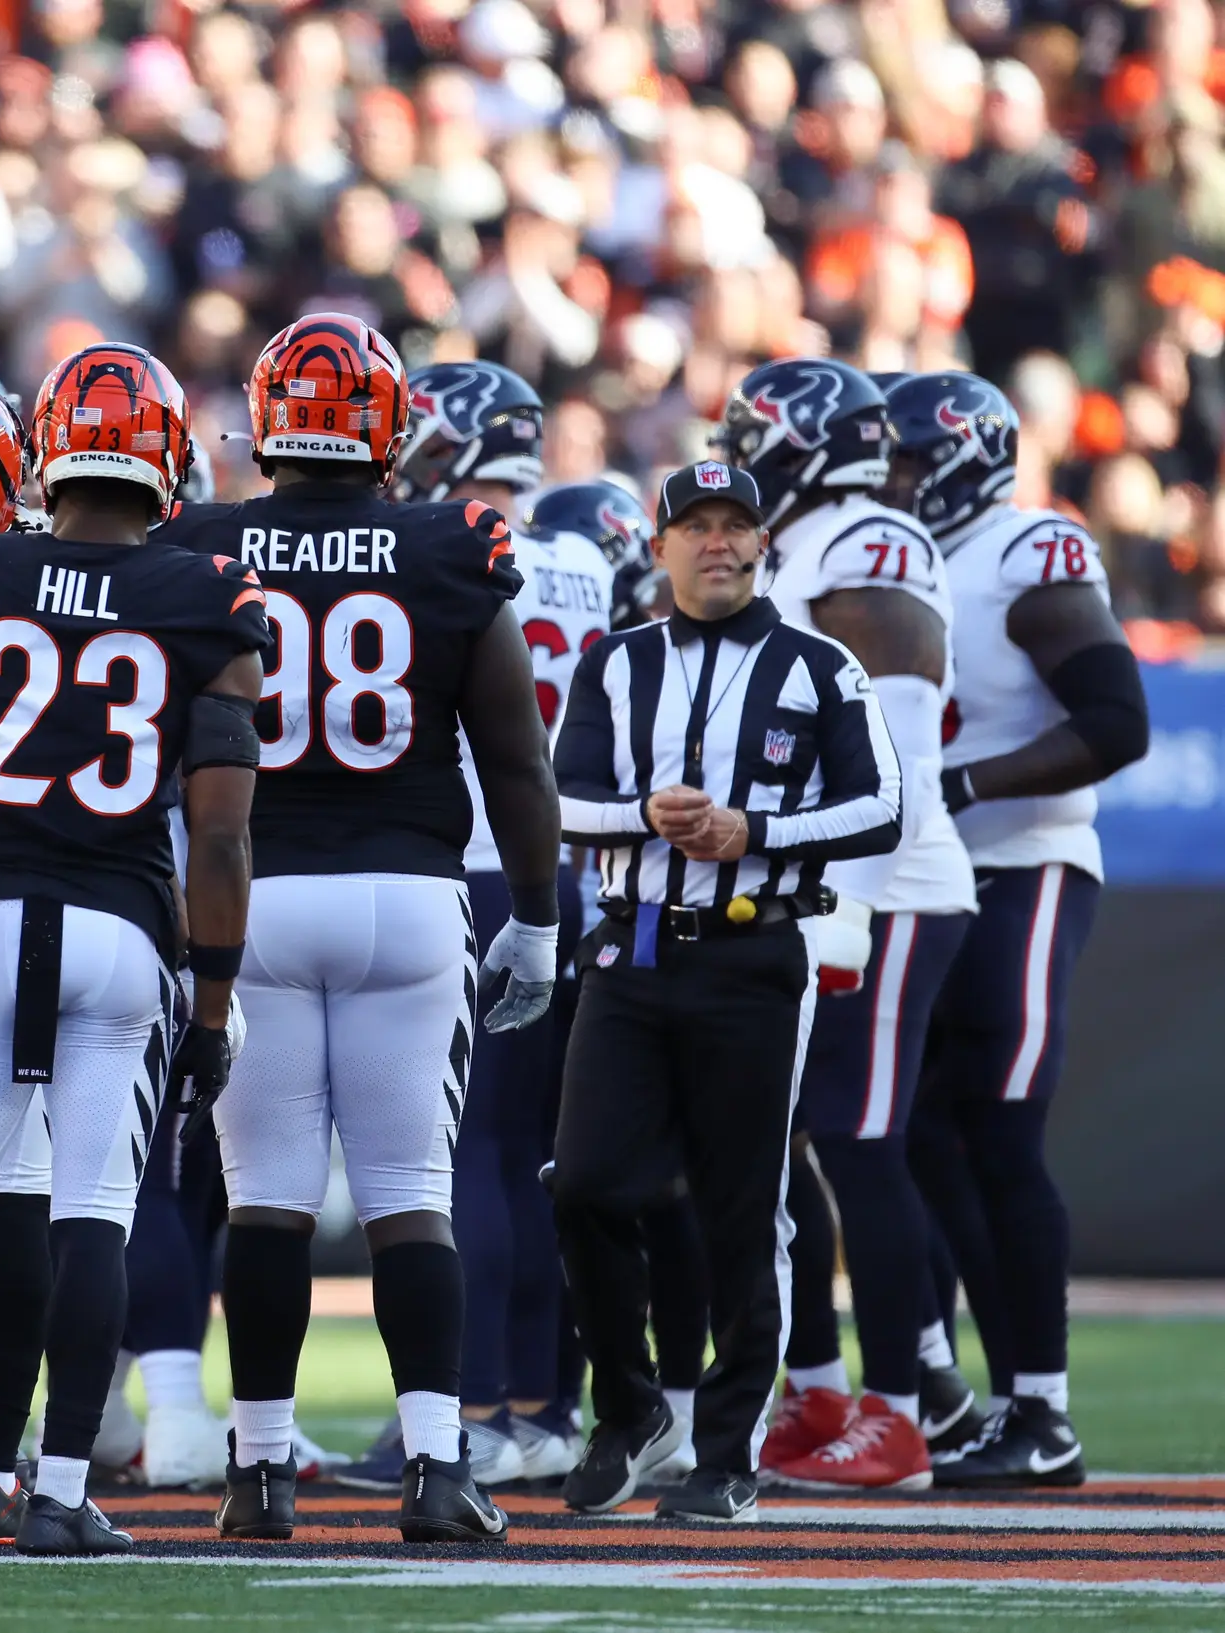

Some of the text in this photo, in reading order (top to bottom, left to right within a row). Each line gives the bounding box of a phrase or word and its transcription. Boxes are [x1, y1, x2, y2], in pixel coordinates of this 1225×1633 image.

[70, 454, 132, 465] BENGALS
[275, 440, 356, 453] BENGALS
[241, 528, 397, 574] READER
[864, 544, 908, 581] 71
[1033, 536, 1088, 584] 78
[36, 565, 118, 621] HILL
[259, 588, 416, 772] 98
